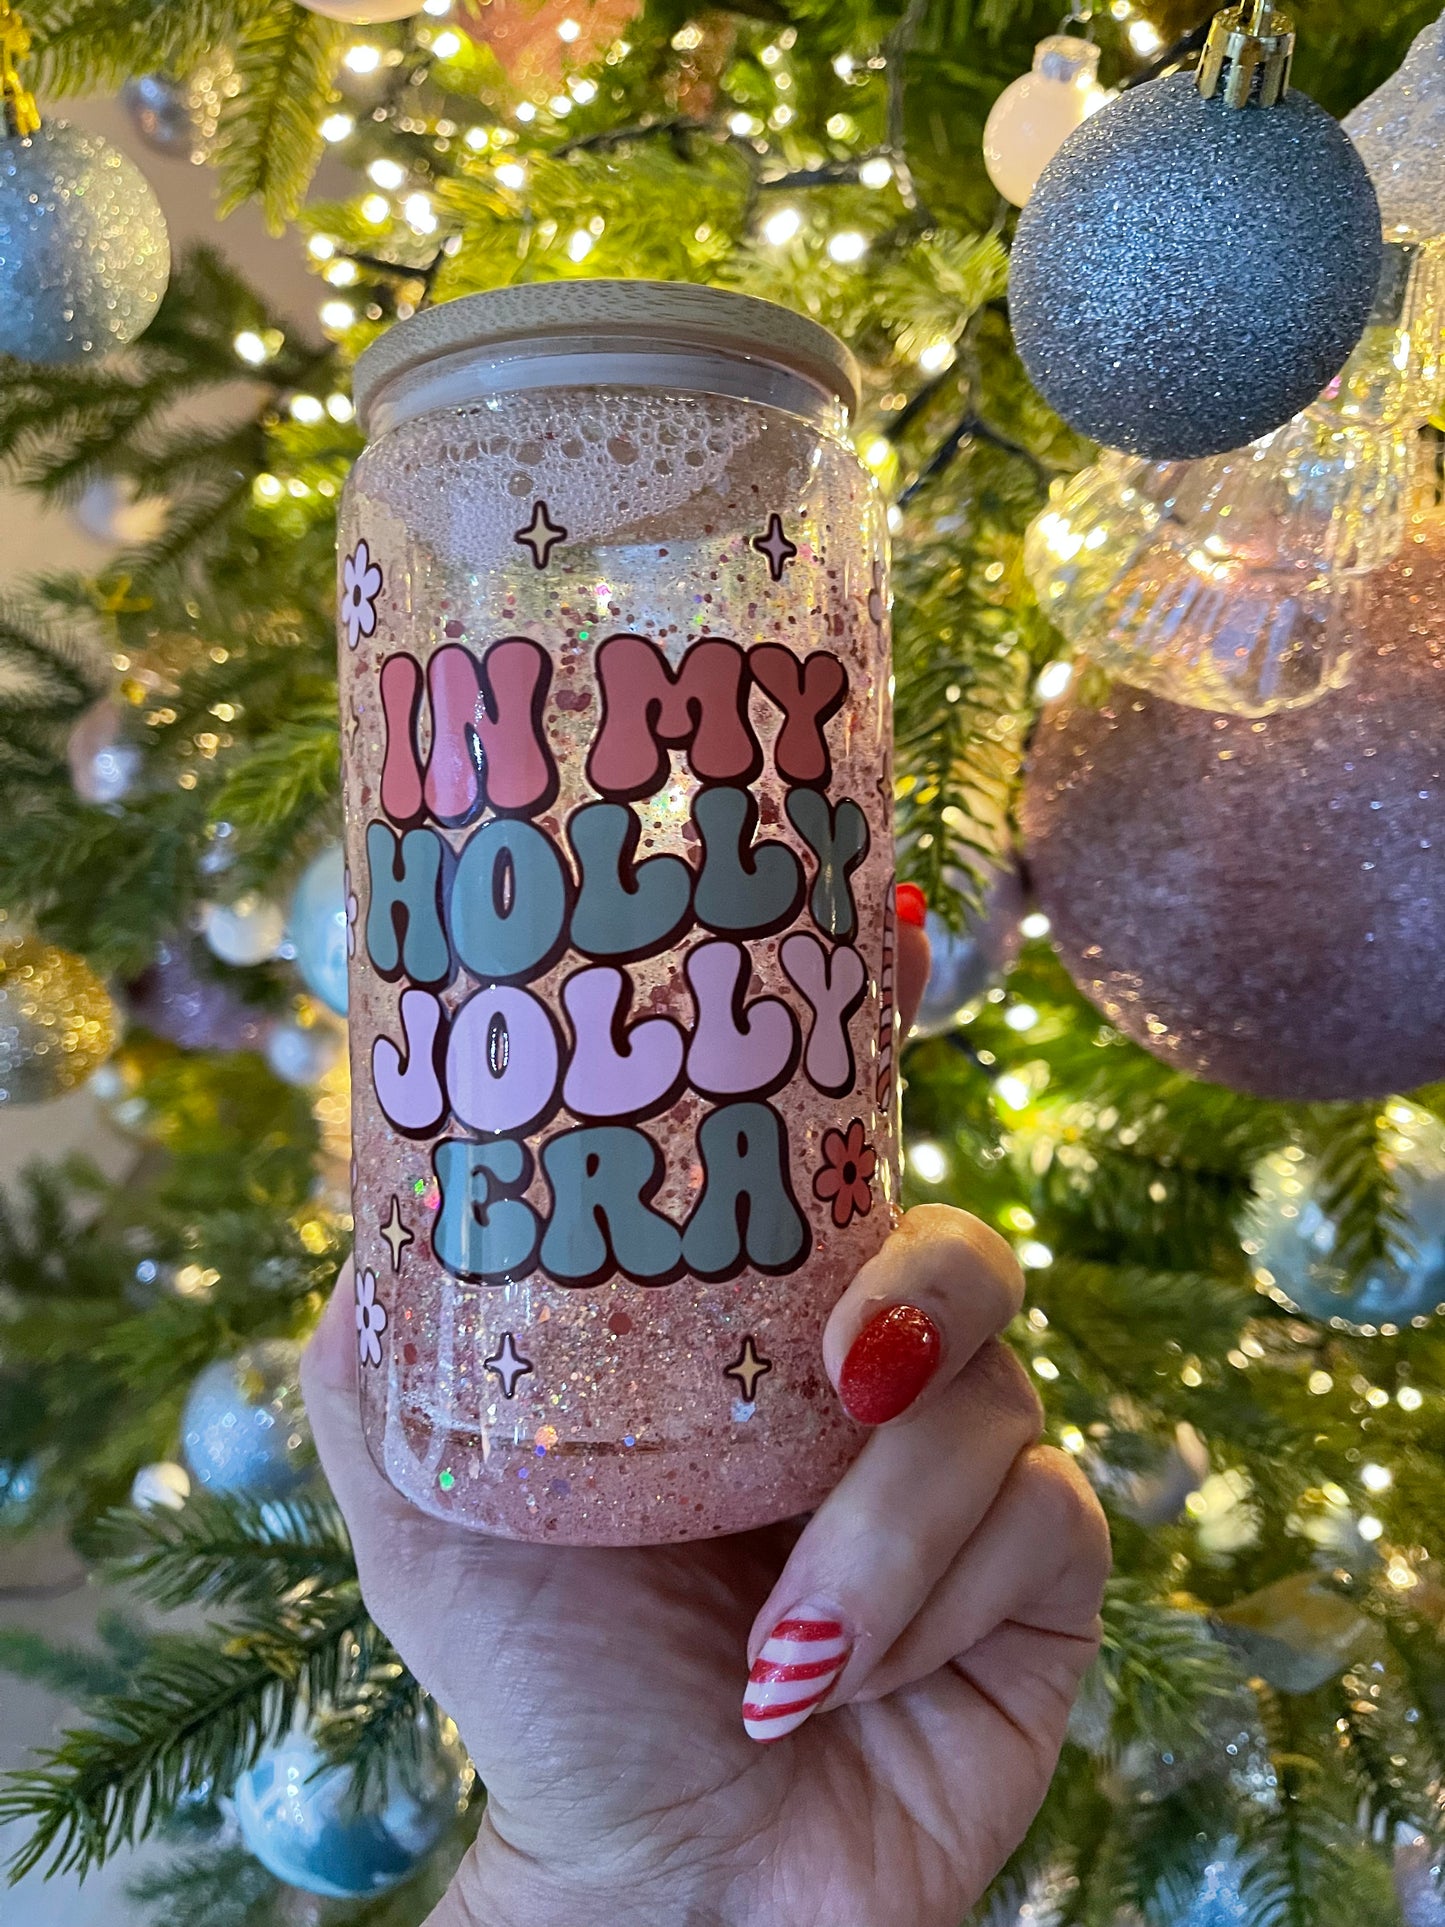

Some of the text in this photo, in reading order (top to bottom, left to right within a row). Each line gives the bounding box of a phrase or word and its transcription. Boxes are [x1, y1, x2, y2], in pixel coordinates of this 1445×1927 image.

[380, 632, 850, 829] IN MY
[365, 785, 871, 989] HOLLY
[371, 931, 869, 1141] JOLLY
[431, 1099, 813, 1288] ERA
